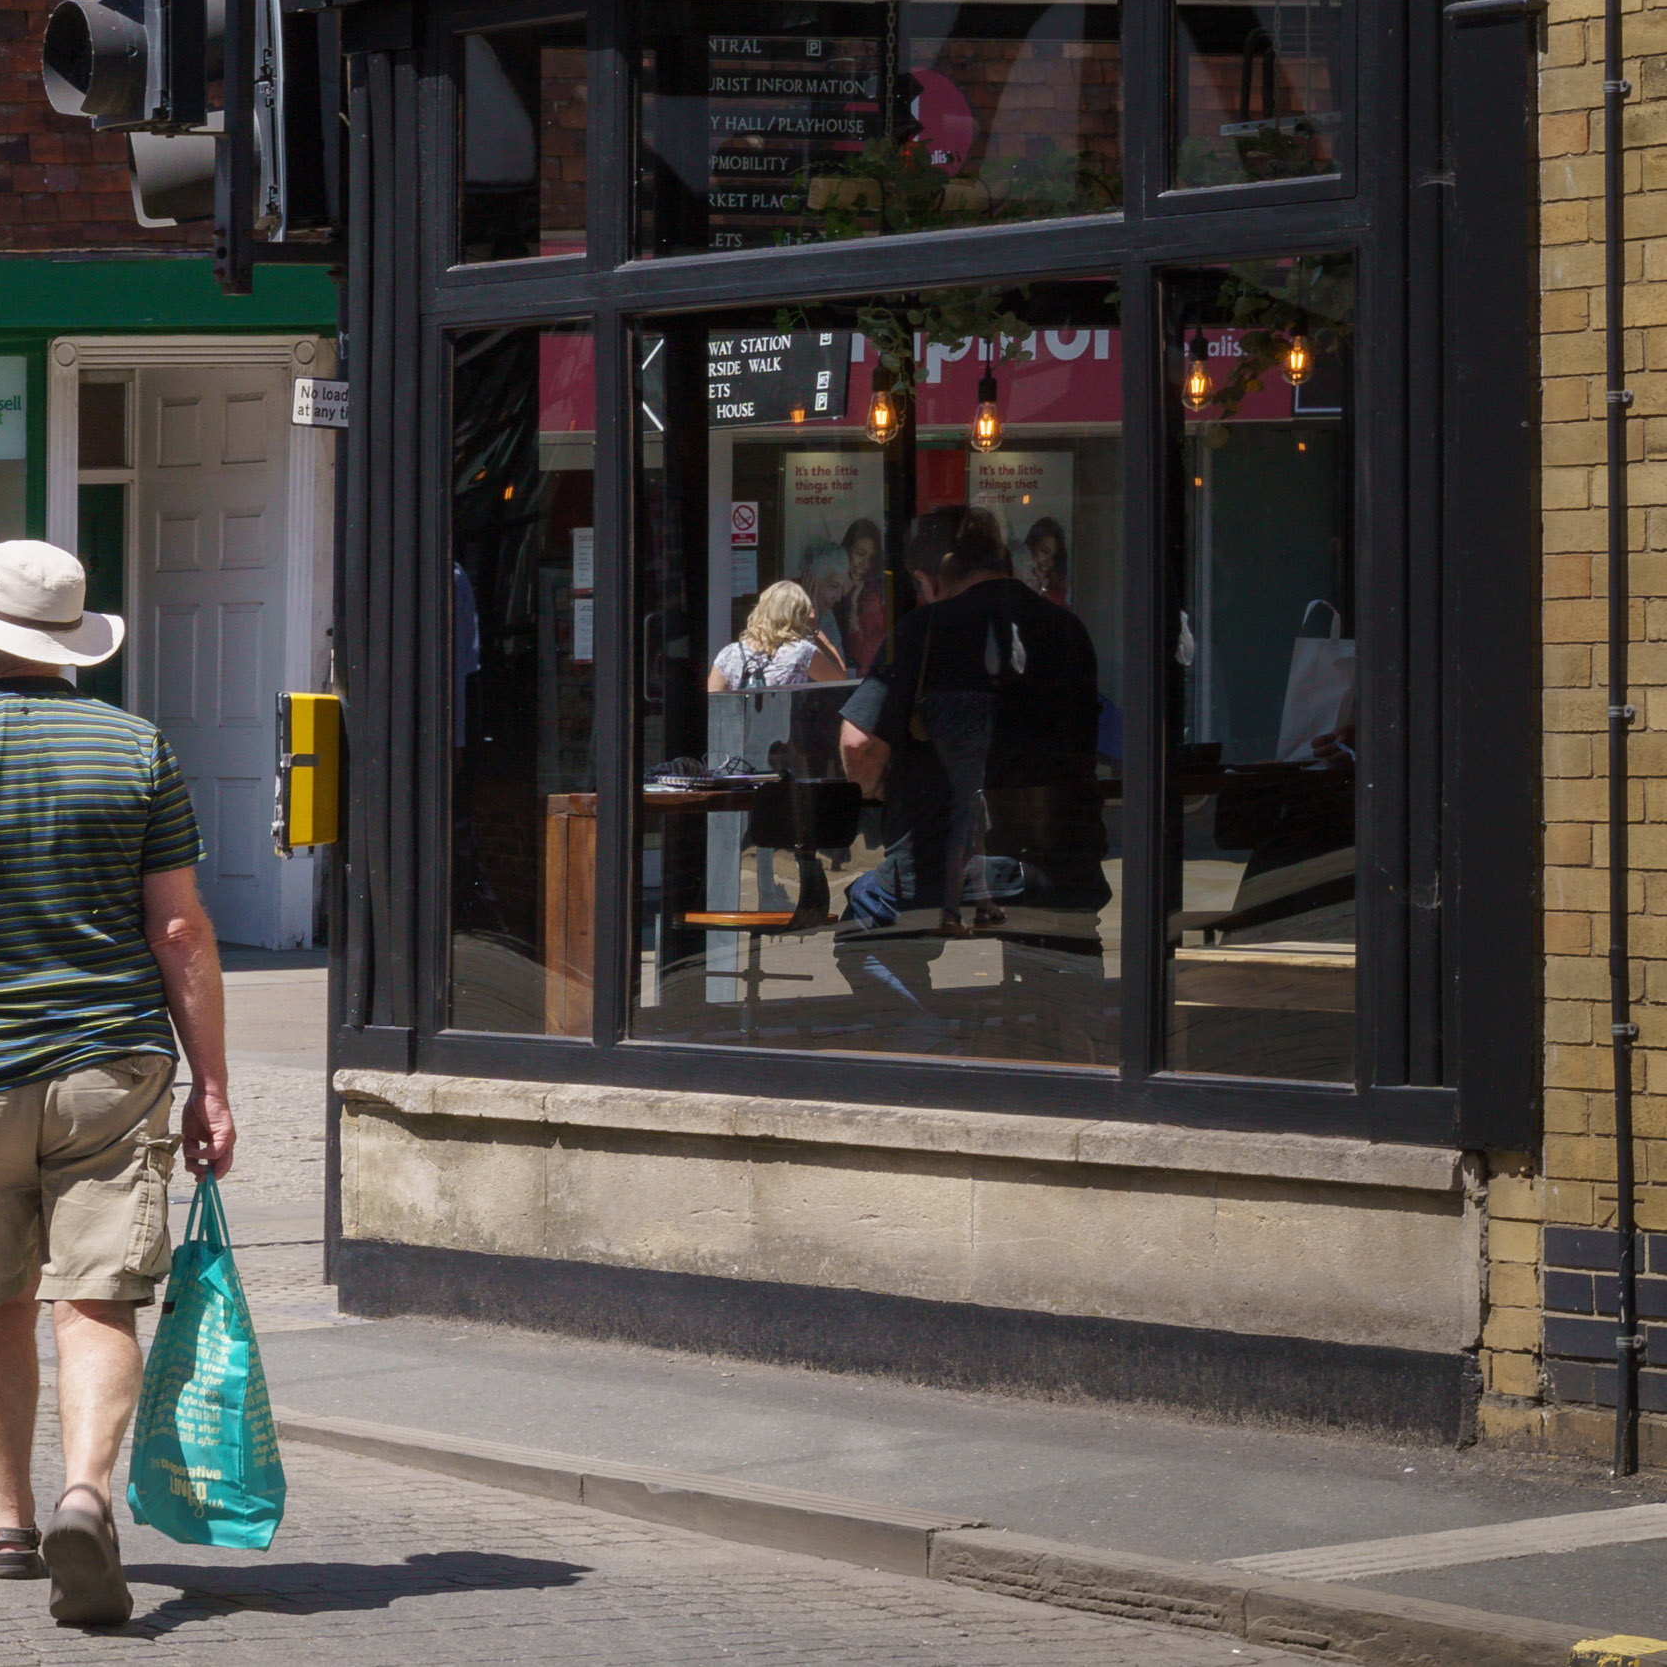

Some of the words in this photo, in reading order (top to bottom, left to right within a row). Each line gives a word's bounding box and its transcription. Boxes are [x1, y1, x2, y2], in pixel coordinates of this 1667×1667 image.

[709, 38, 762, 54] NTRAL
[757, 78, 866, 94] INFORMATION
[710, 115, 721, 130] Y
[708, 155, 789, 171] PMOBILITY
[709, 193, 748, 208] RKET
[752, 194, 800, 208] PLAC
[709, 340, 734, 356] WAY
[740, 334, 792, 354] STATION
[708, 360, 742, 377] RSIDE
[749, 356, 782, 373] WALK
[301, 385, 318, 400] No
[322, 387, 349, 401] load
[708, 383, 731, 399] ETS
[298, 404, 310, 417] at
[314, 406, 336, 421] any
[717, 402, 755, 419] HOUSE
[795, 465, 809, 477] It's
[811, 465, 831, 477] the
[835, 465, 859, 477] little
[979, 464, 995, 476] It's
[998, 464, 1015, 476] the
[1018, 464, 1043, 476] little
[795, 480, 828, 493] things
[831, 479, 853, 491] that
[979, 478, 1012, 492] things
[1015, 478, 1039, 490] that
[795, 494, 835, 506] matter
[979, 492, 1016, 505] matter
[202, 1362, 227, 1374] after
[201, 1374, 225, 1386] after
[198, 1424, 221, 1434] after
[198, 1436, 221, 1447] after
